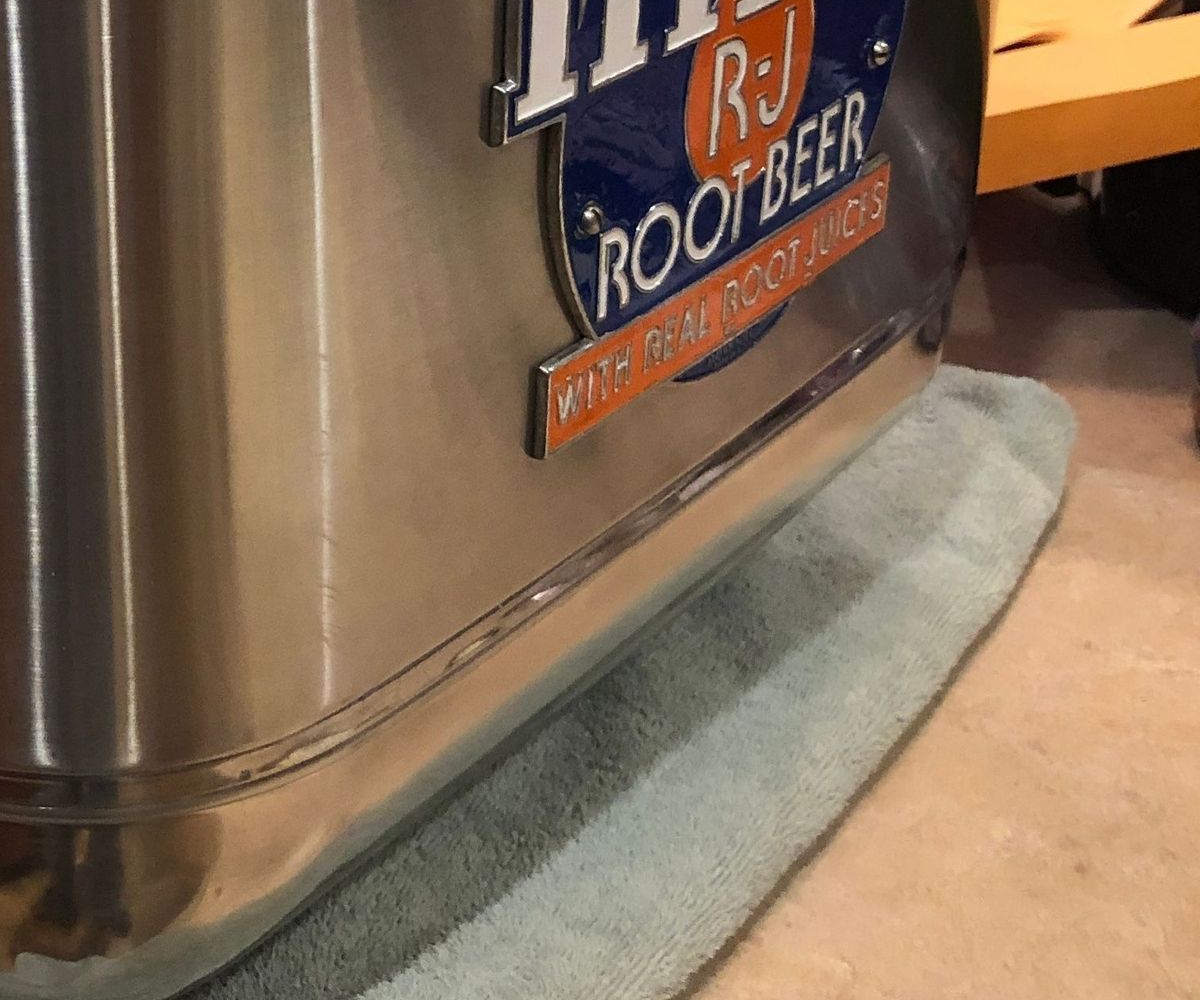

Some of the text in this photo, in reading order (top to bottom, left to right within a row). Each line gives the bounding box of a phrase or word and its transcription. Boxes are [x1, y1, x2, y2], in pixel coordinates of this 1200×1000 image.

[708, 6, 797, 162] R-J
[555, 341, 633, 425] WITH
[643, 295, 712, 374] REAL
[722, 238, 800, 328] ROOT
[805, 180, 885, 268] JUICES
[596, 89, 867, 322] ROOT BEER
